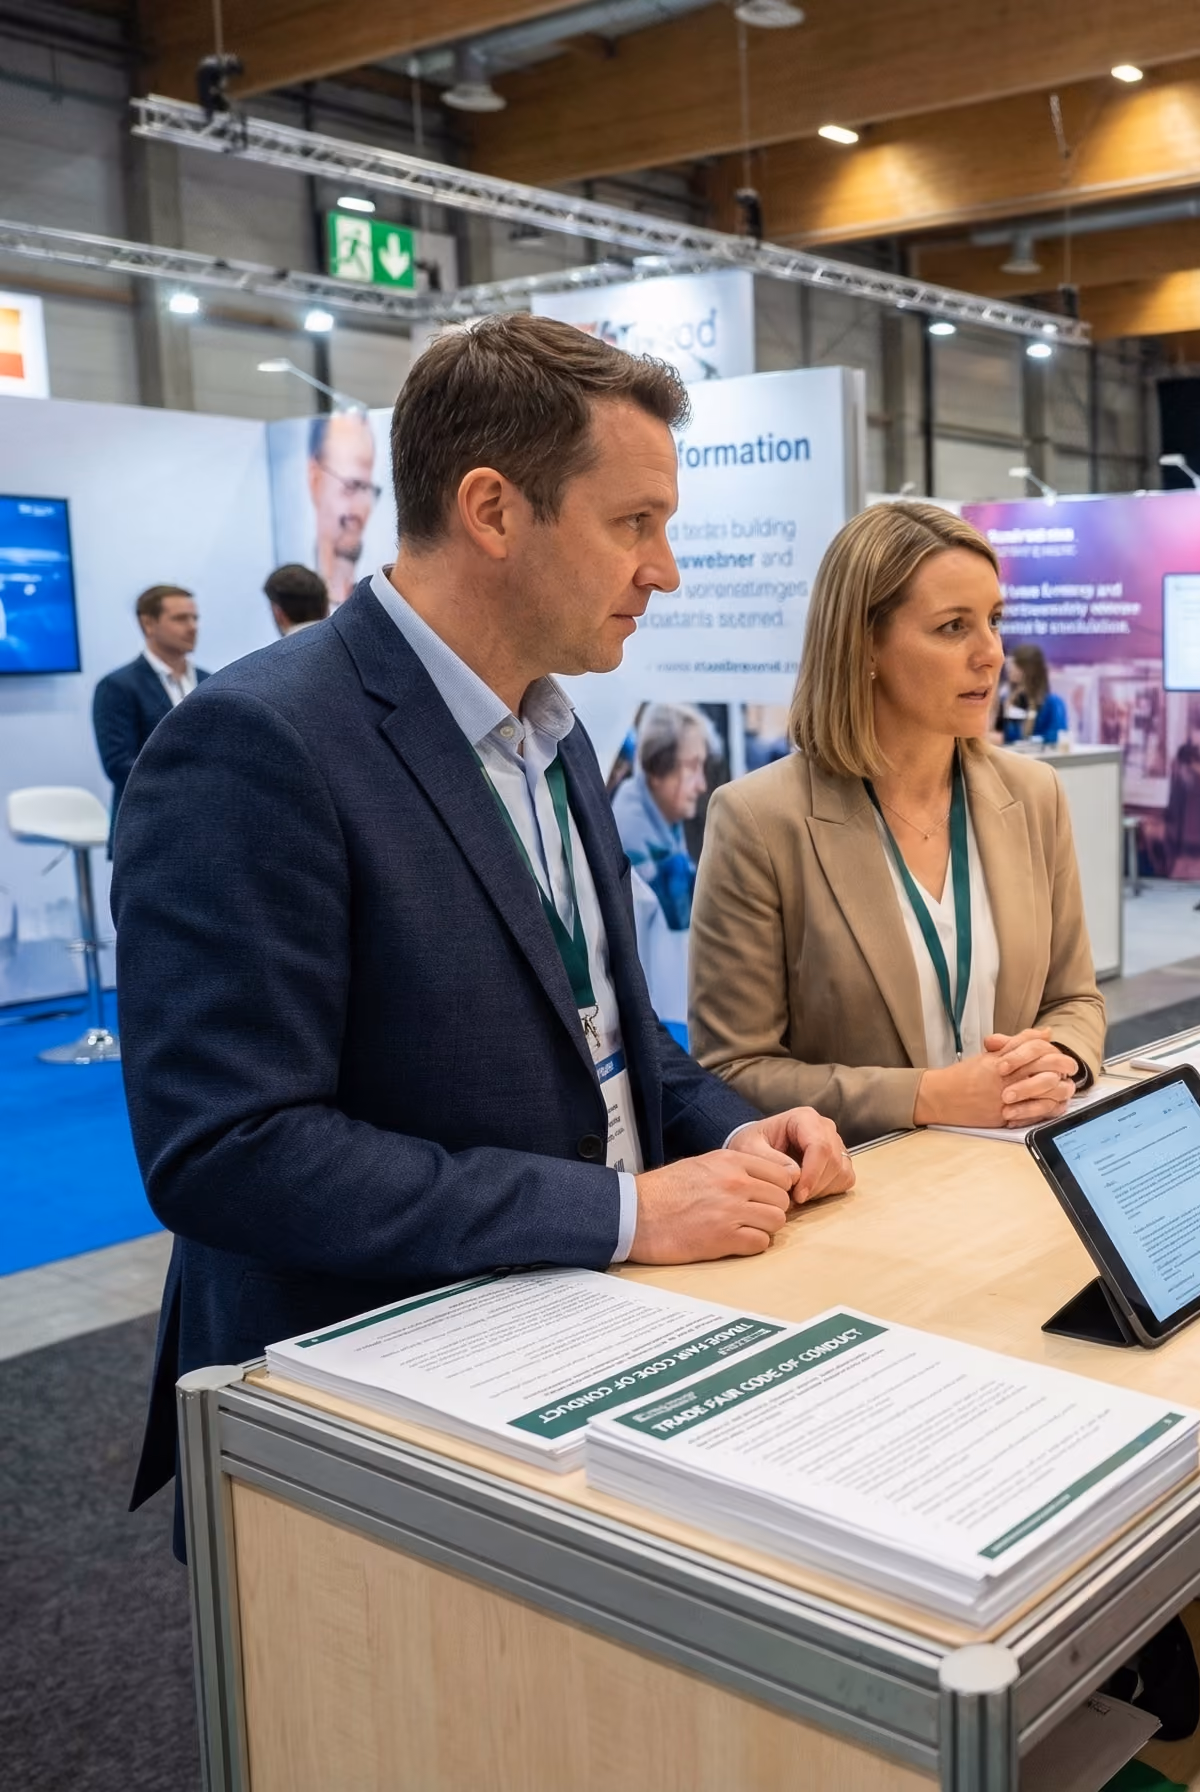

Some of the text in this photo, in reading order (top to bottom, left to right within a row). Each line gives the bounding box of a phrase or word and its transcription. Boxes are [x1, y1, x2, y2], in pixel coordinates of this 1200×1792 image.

[709, 1322, 754, 1347] TRADE
[679, 1342, 710, 1362] FAIR
[638, 1358, 677, 1380] CODE
[651, 1403, 708, 1433] TRADE
[704, 1386, 743, 1410] FAIR
[739, 1367, 783, 1392] CODE
[778, 1357, 801, 1374] OF
[799, 1327, 864, 1363] CONDUCT
[615, 1375, 636, 1391] OF
[539, 1387, 613, 1424] CONDUCT
